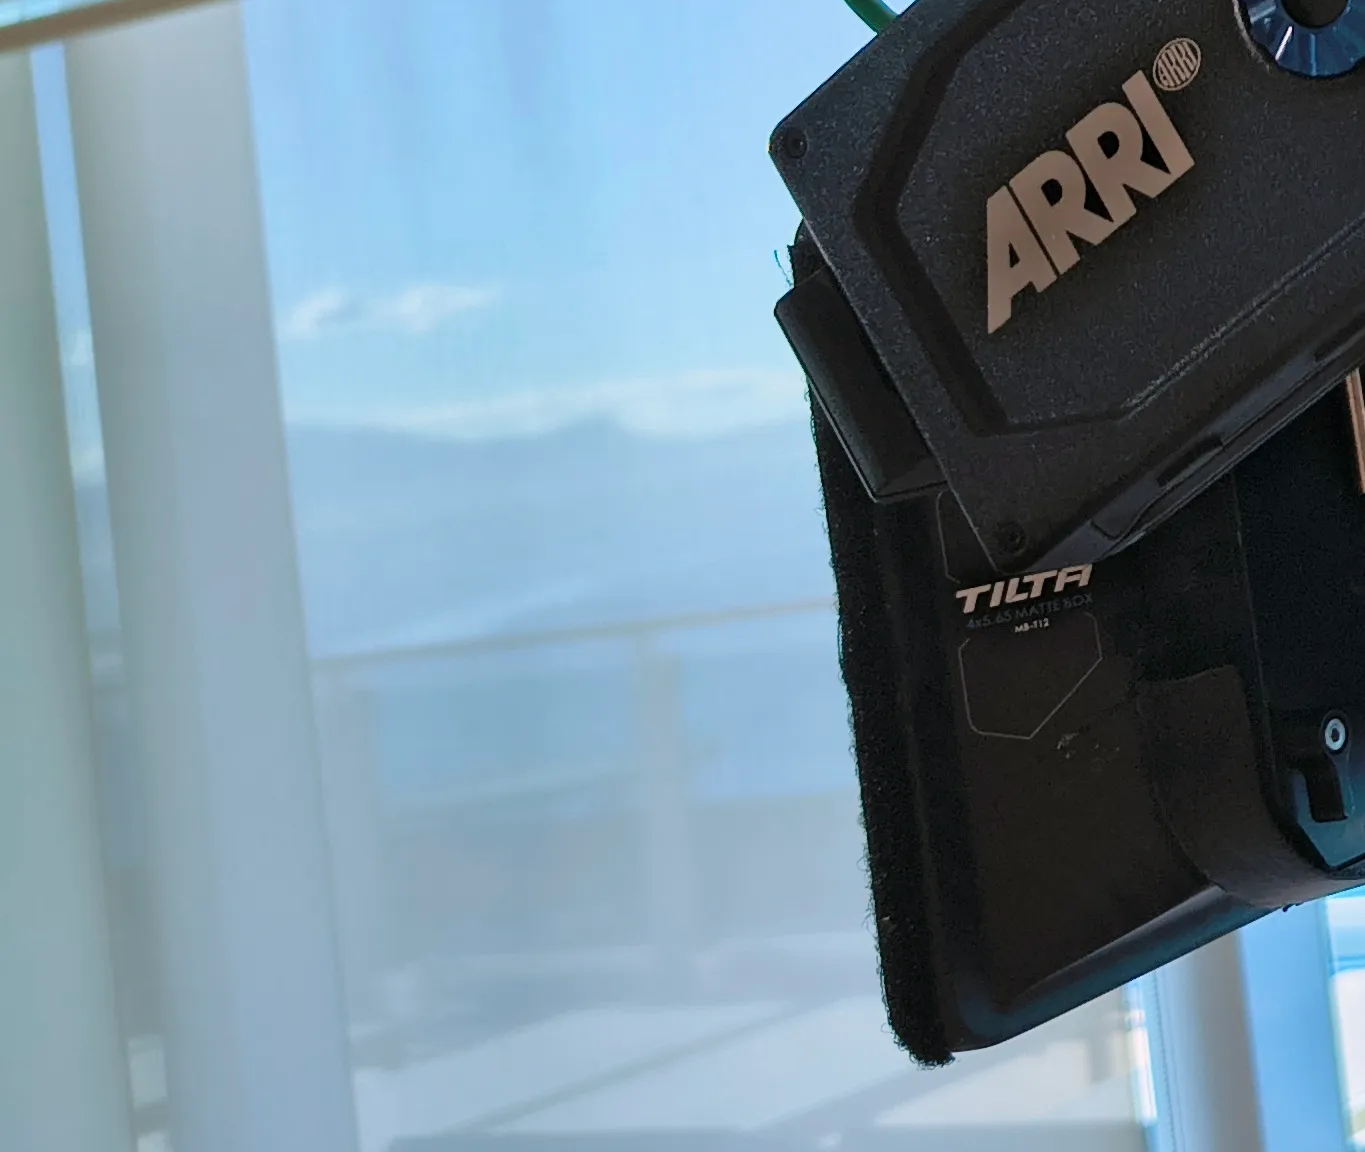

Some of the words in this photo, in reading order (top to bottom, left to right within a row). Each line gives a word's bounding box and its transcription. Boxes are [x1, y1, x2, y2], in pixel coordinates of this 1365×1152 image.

[987, 69, 1195, 335] ARRI
[955, 563, 1093, 614] TILTA
[1015, 599, 1061, 619] MATTE
[1062, 593, 1094, 609] BOX
[1014, 618, 1050, 633] MB-T12
